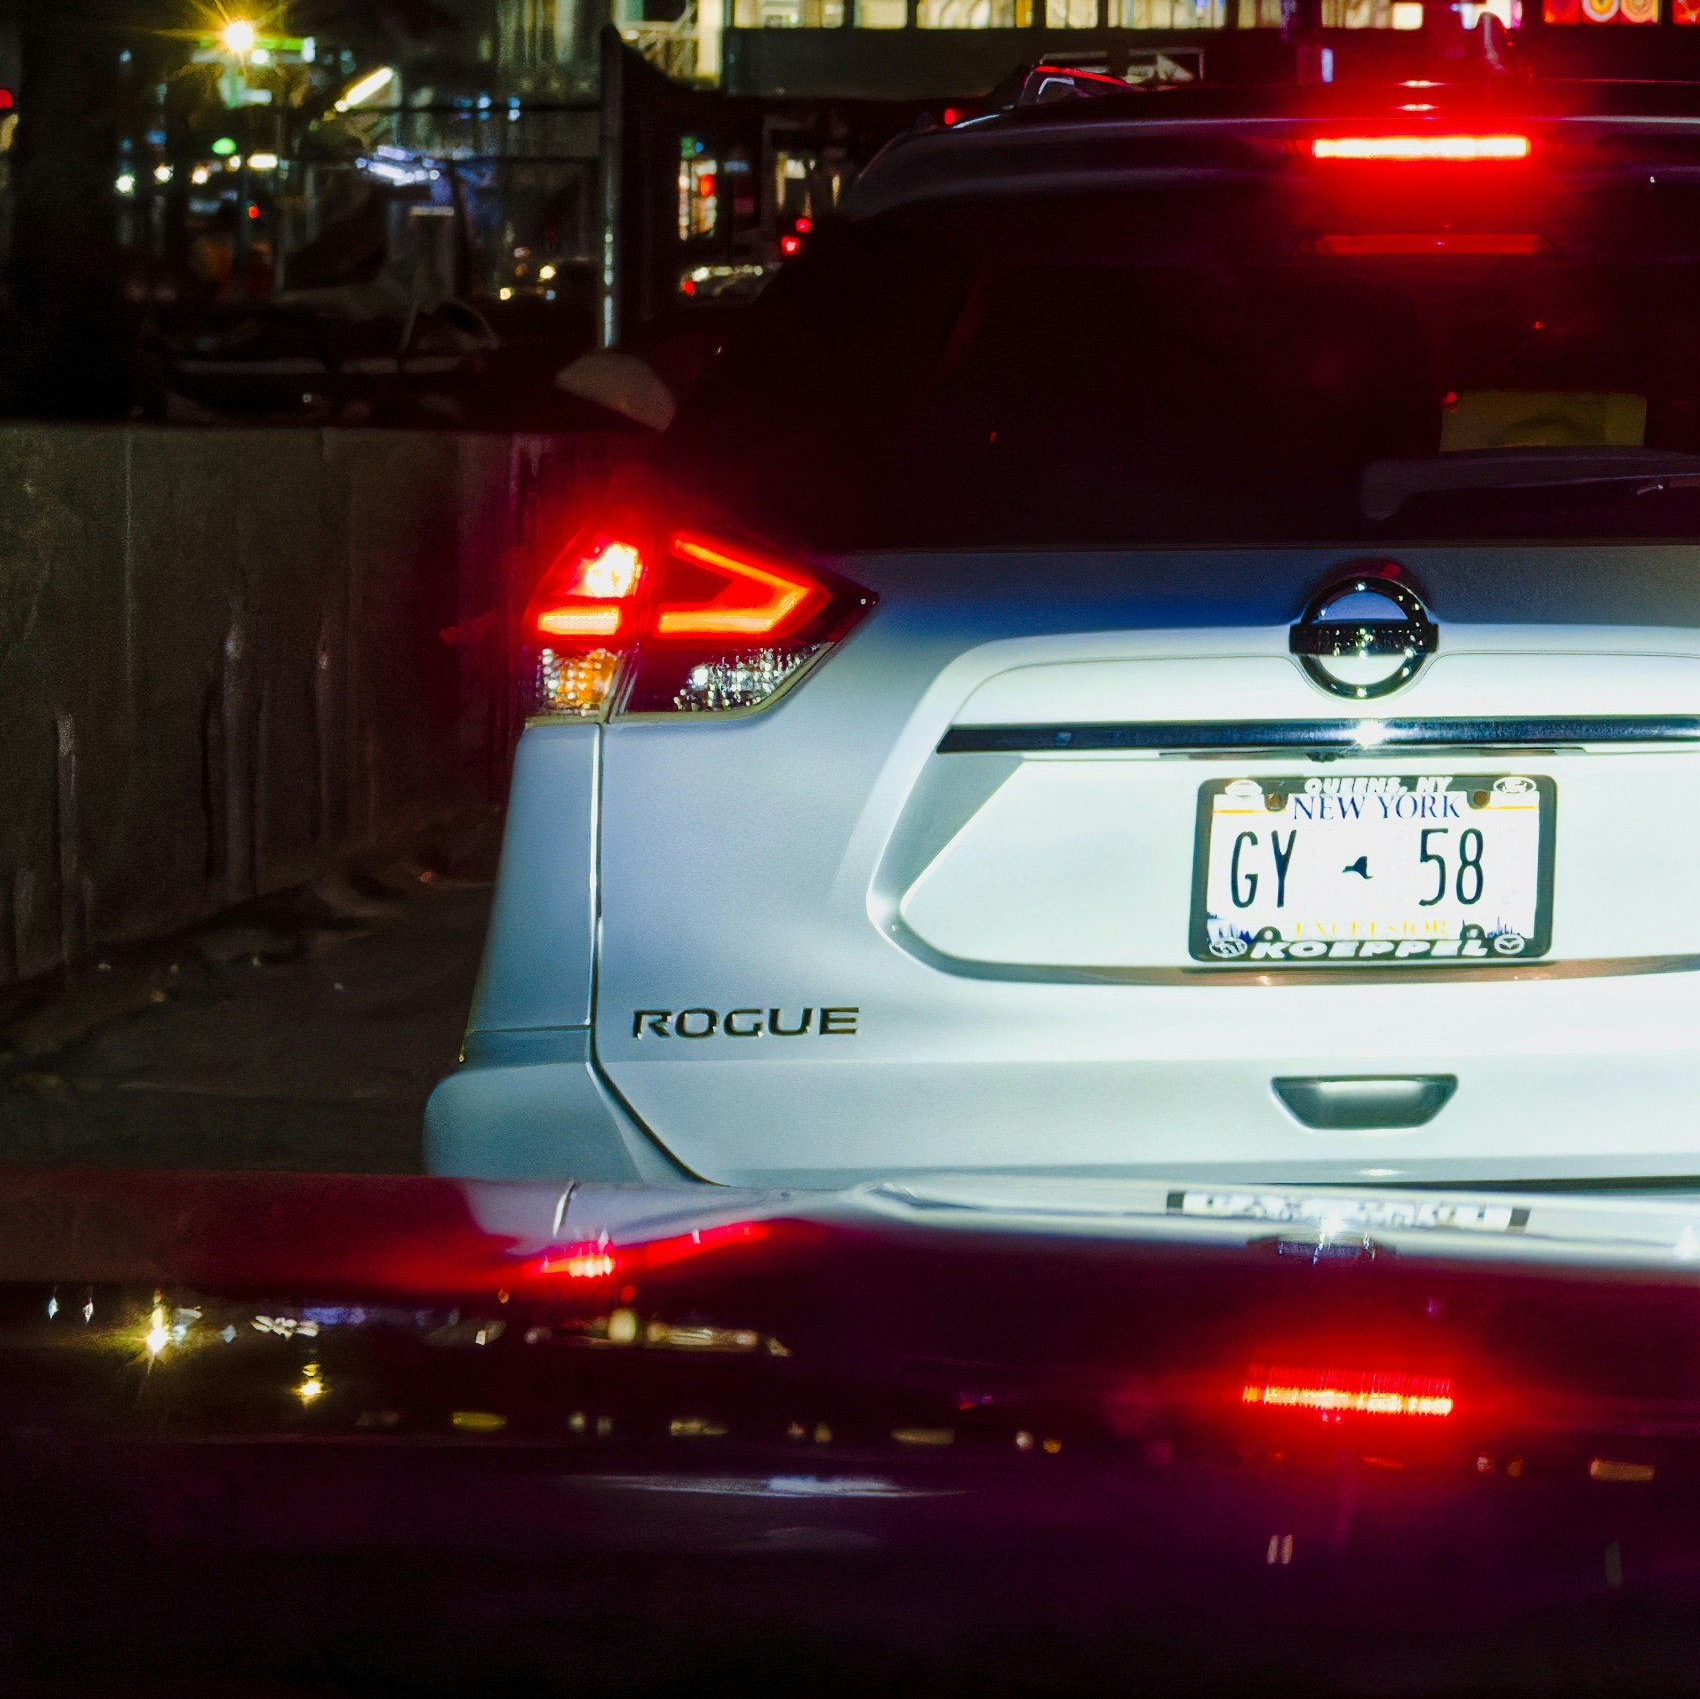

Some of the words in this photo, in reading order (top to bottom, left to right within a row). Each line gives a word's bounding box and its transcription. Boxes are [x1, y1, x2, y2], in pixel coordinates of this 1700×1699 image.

[1414, 776, 1453, 794] NY
[1293, 795, 1367, 820] NEW
[1379, 793, 1461, 819] YORK
[1231, 828, 1297, 908] GY
[1418, 827, 1484, 906] 58
[1250, 940, 1488, 959] KOEPPEL
[632, 1006, 861, 1039] ROGUE
